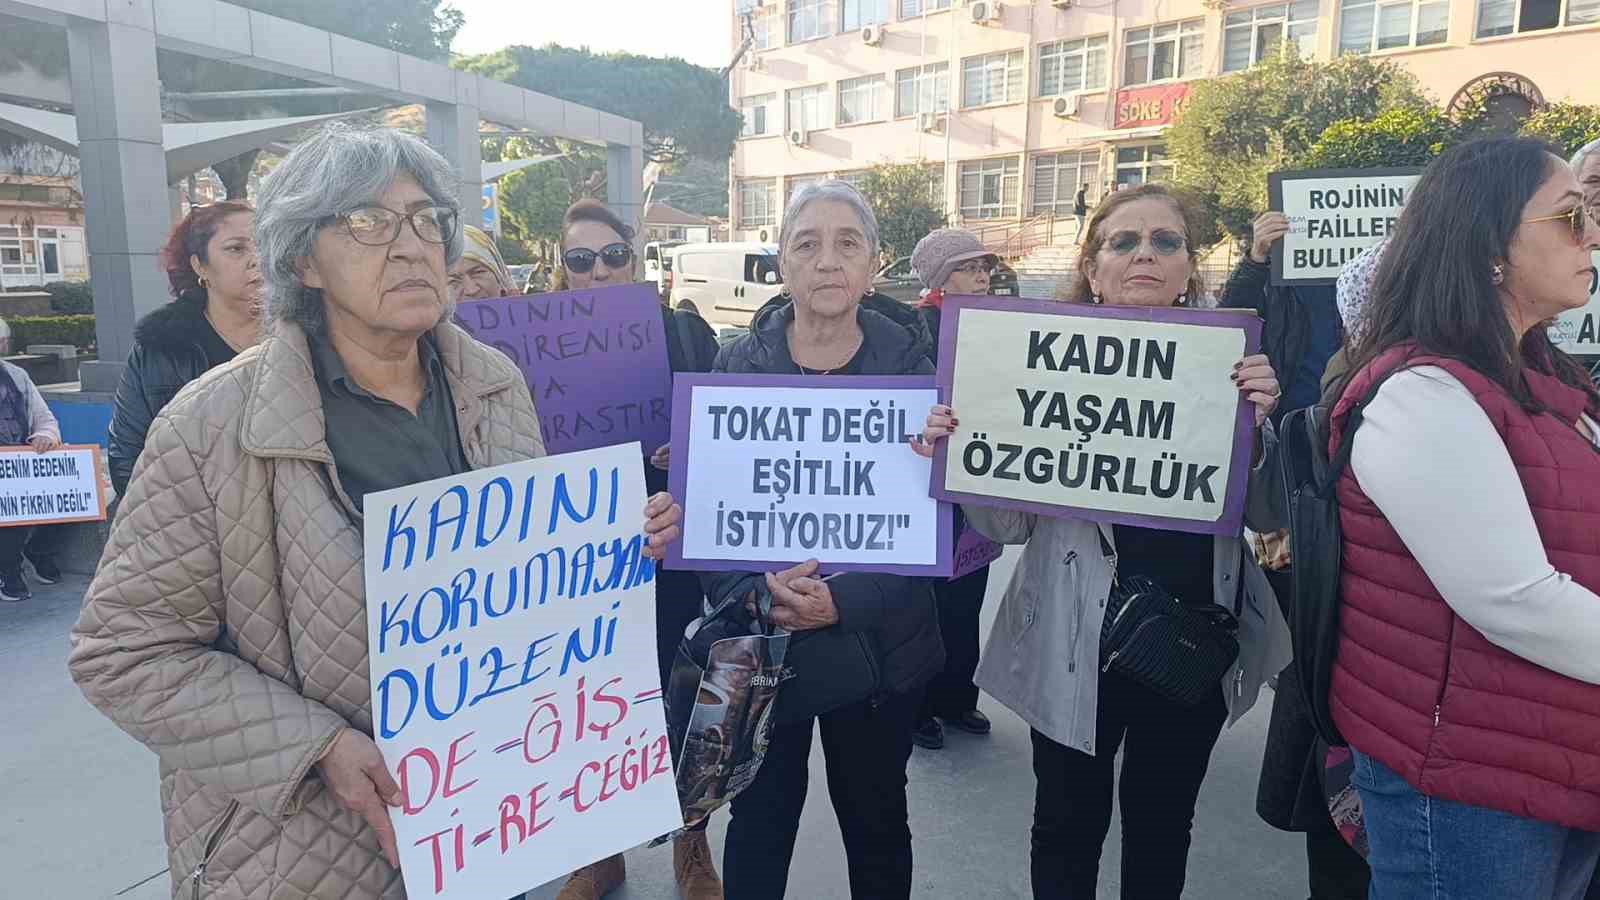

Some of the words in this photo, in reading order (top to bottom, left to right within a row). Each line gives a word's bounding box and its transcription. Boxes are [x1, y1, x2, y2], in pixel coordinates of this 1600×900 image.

[1310, 184, 1404, 209] ROJİNİN
[1294, 247, 1363, 268] BULU
[1026, 330, 1177, 381] KADIN
[708, 405, 812, 442] TOKAT
[1016, 388, 1176, 443] YAŞAM
[0, 454, 30, 478] BENİM
[32, 452, 80, 480] BEDENİM,
[752, 450, 876, 504] EŞİTLİK
[962, 432, 1221, 504] ÖZGÜRLÜK
[20, 490, 55, 515] FİKRİN
[382, 466, 618, 573] KADINI
[715, 501, 910, 551] İSTİYORUZ!"
[378, 534, 656, 654] KORUMAYAN
[377, 601, 621, 739] DÜZENİ
